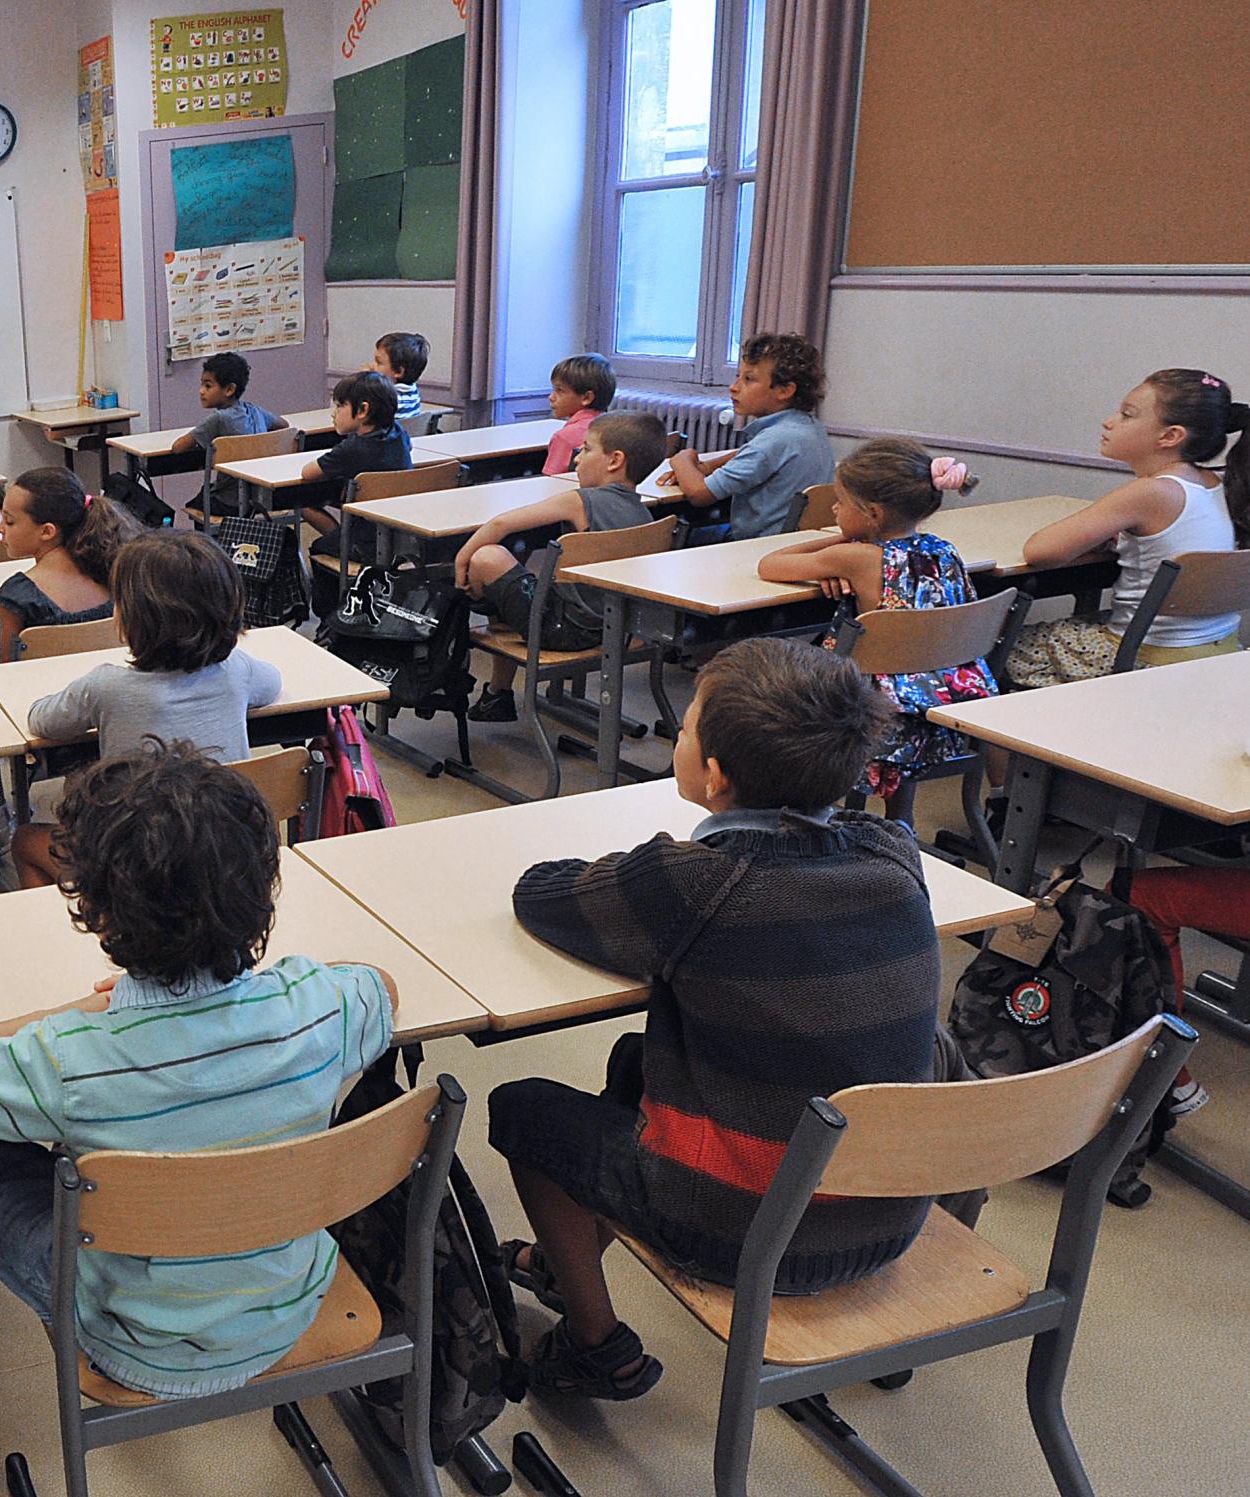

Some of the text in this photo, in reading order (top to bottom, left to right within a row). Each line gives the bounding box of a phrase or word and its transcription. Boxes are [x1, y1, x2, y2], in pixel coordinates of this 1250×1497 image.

[179, 14, 271, 30] THE ENGLISH ALPHABET
[1005, 996, 1050, 1025] FIGHTING FALCON
